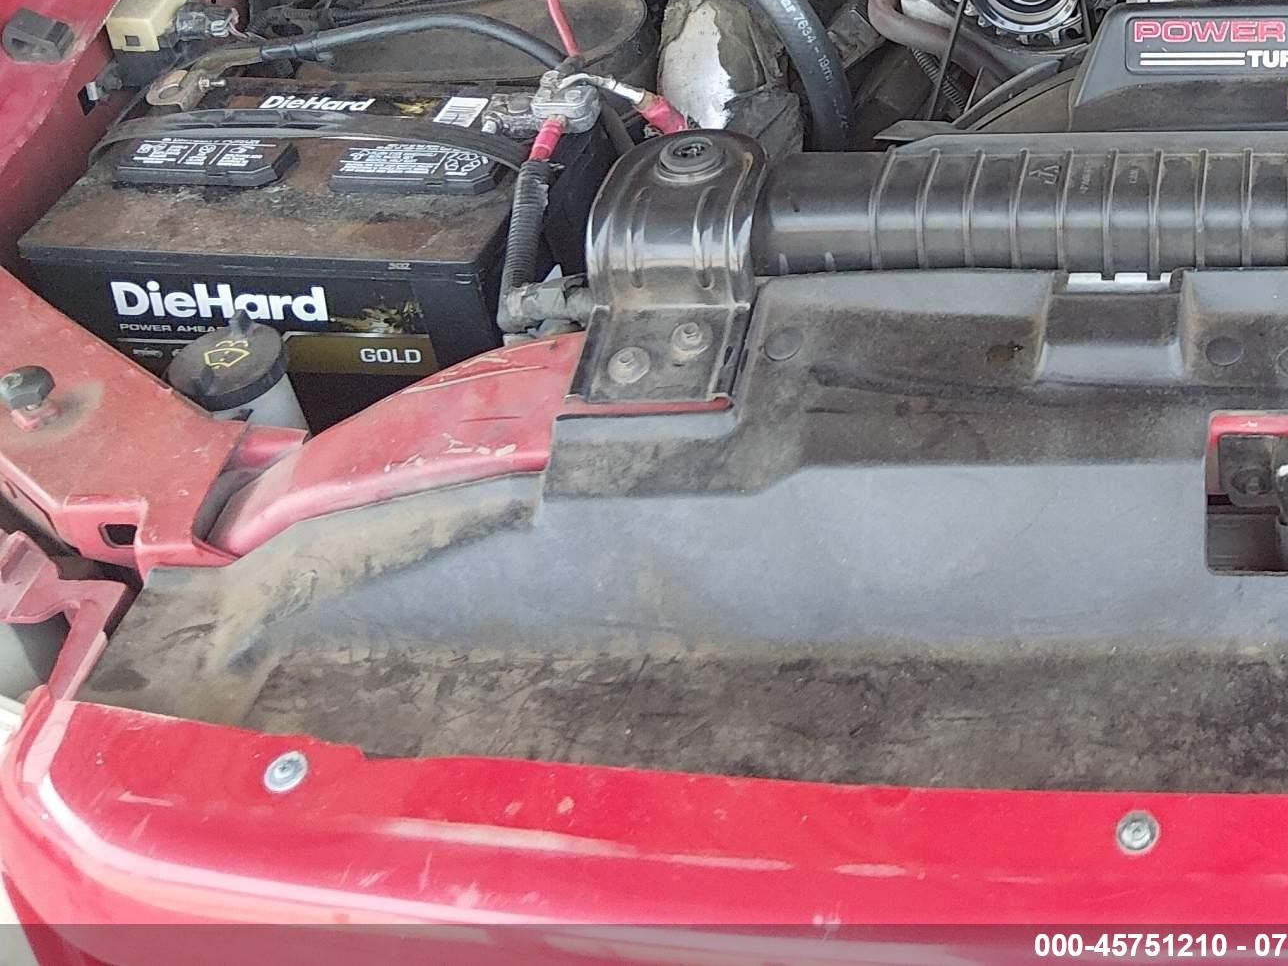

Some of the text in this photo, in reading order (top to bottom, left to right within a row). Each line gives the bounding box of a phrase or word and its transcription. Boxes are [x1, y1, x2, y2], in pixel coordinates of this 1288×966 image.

[793, 10, 818, 43] 7634
[1134, 20, 1287, 43] POWER
[258, 95, 376, 112] DieHard
[110, 281, 328, 322] DieHard
[119, 323, 225, 333] POWER AHEA
[359, 348, 421, 364] GOLD
